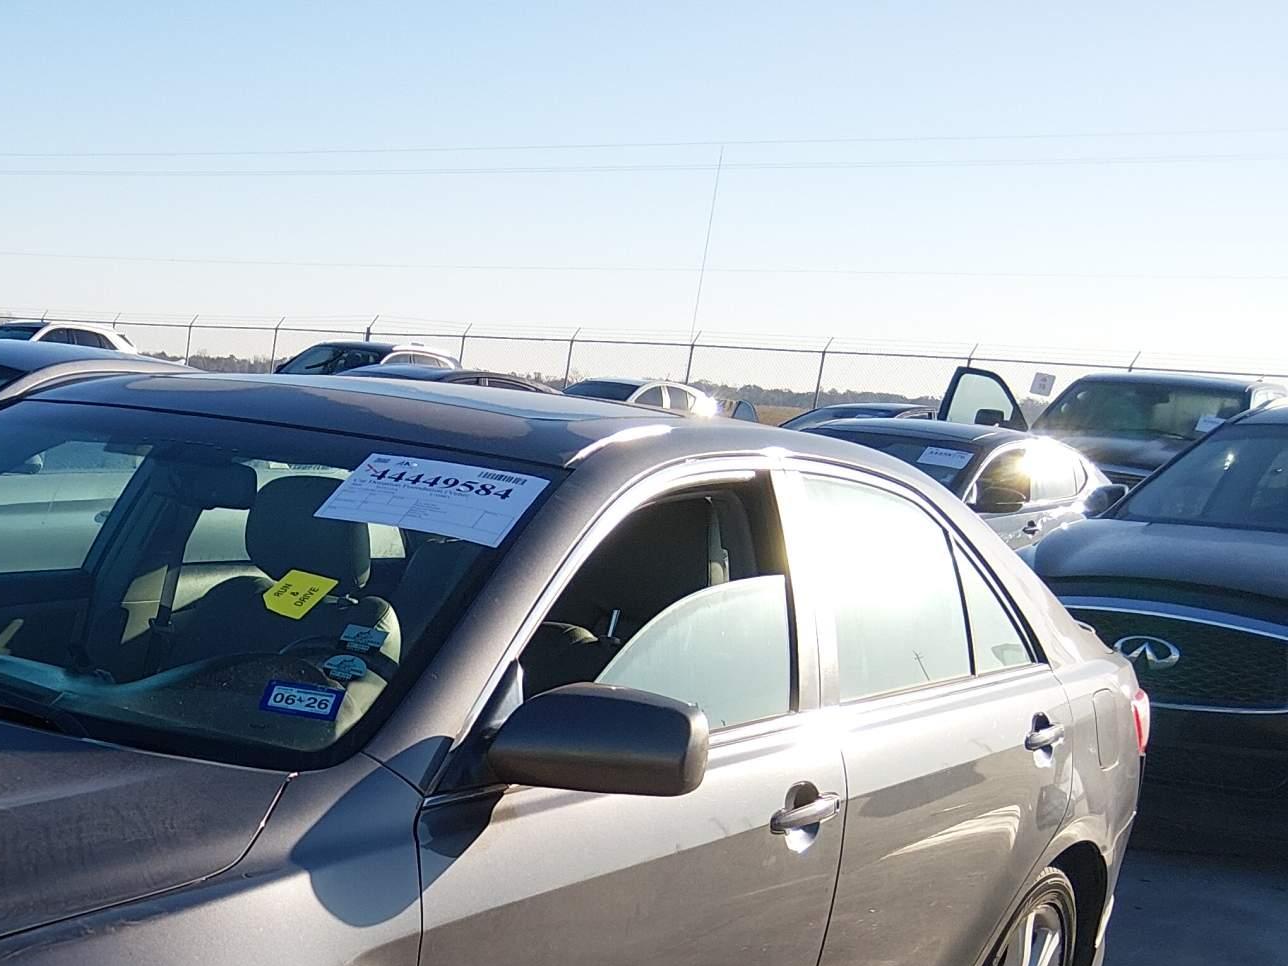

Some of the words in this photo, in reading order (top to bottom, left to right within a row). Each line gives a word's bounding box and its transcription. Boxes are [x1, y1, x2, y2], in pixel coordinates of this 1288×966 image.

[370, 468, 513, 500] 44449584
[273, 583, 292, 597] RUN
[294, 586, 320, 607] DRIVE
